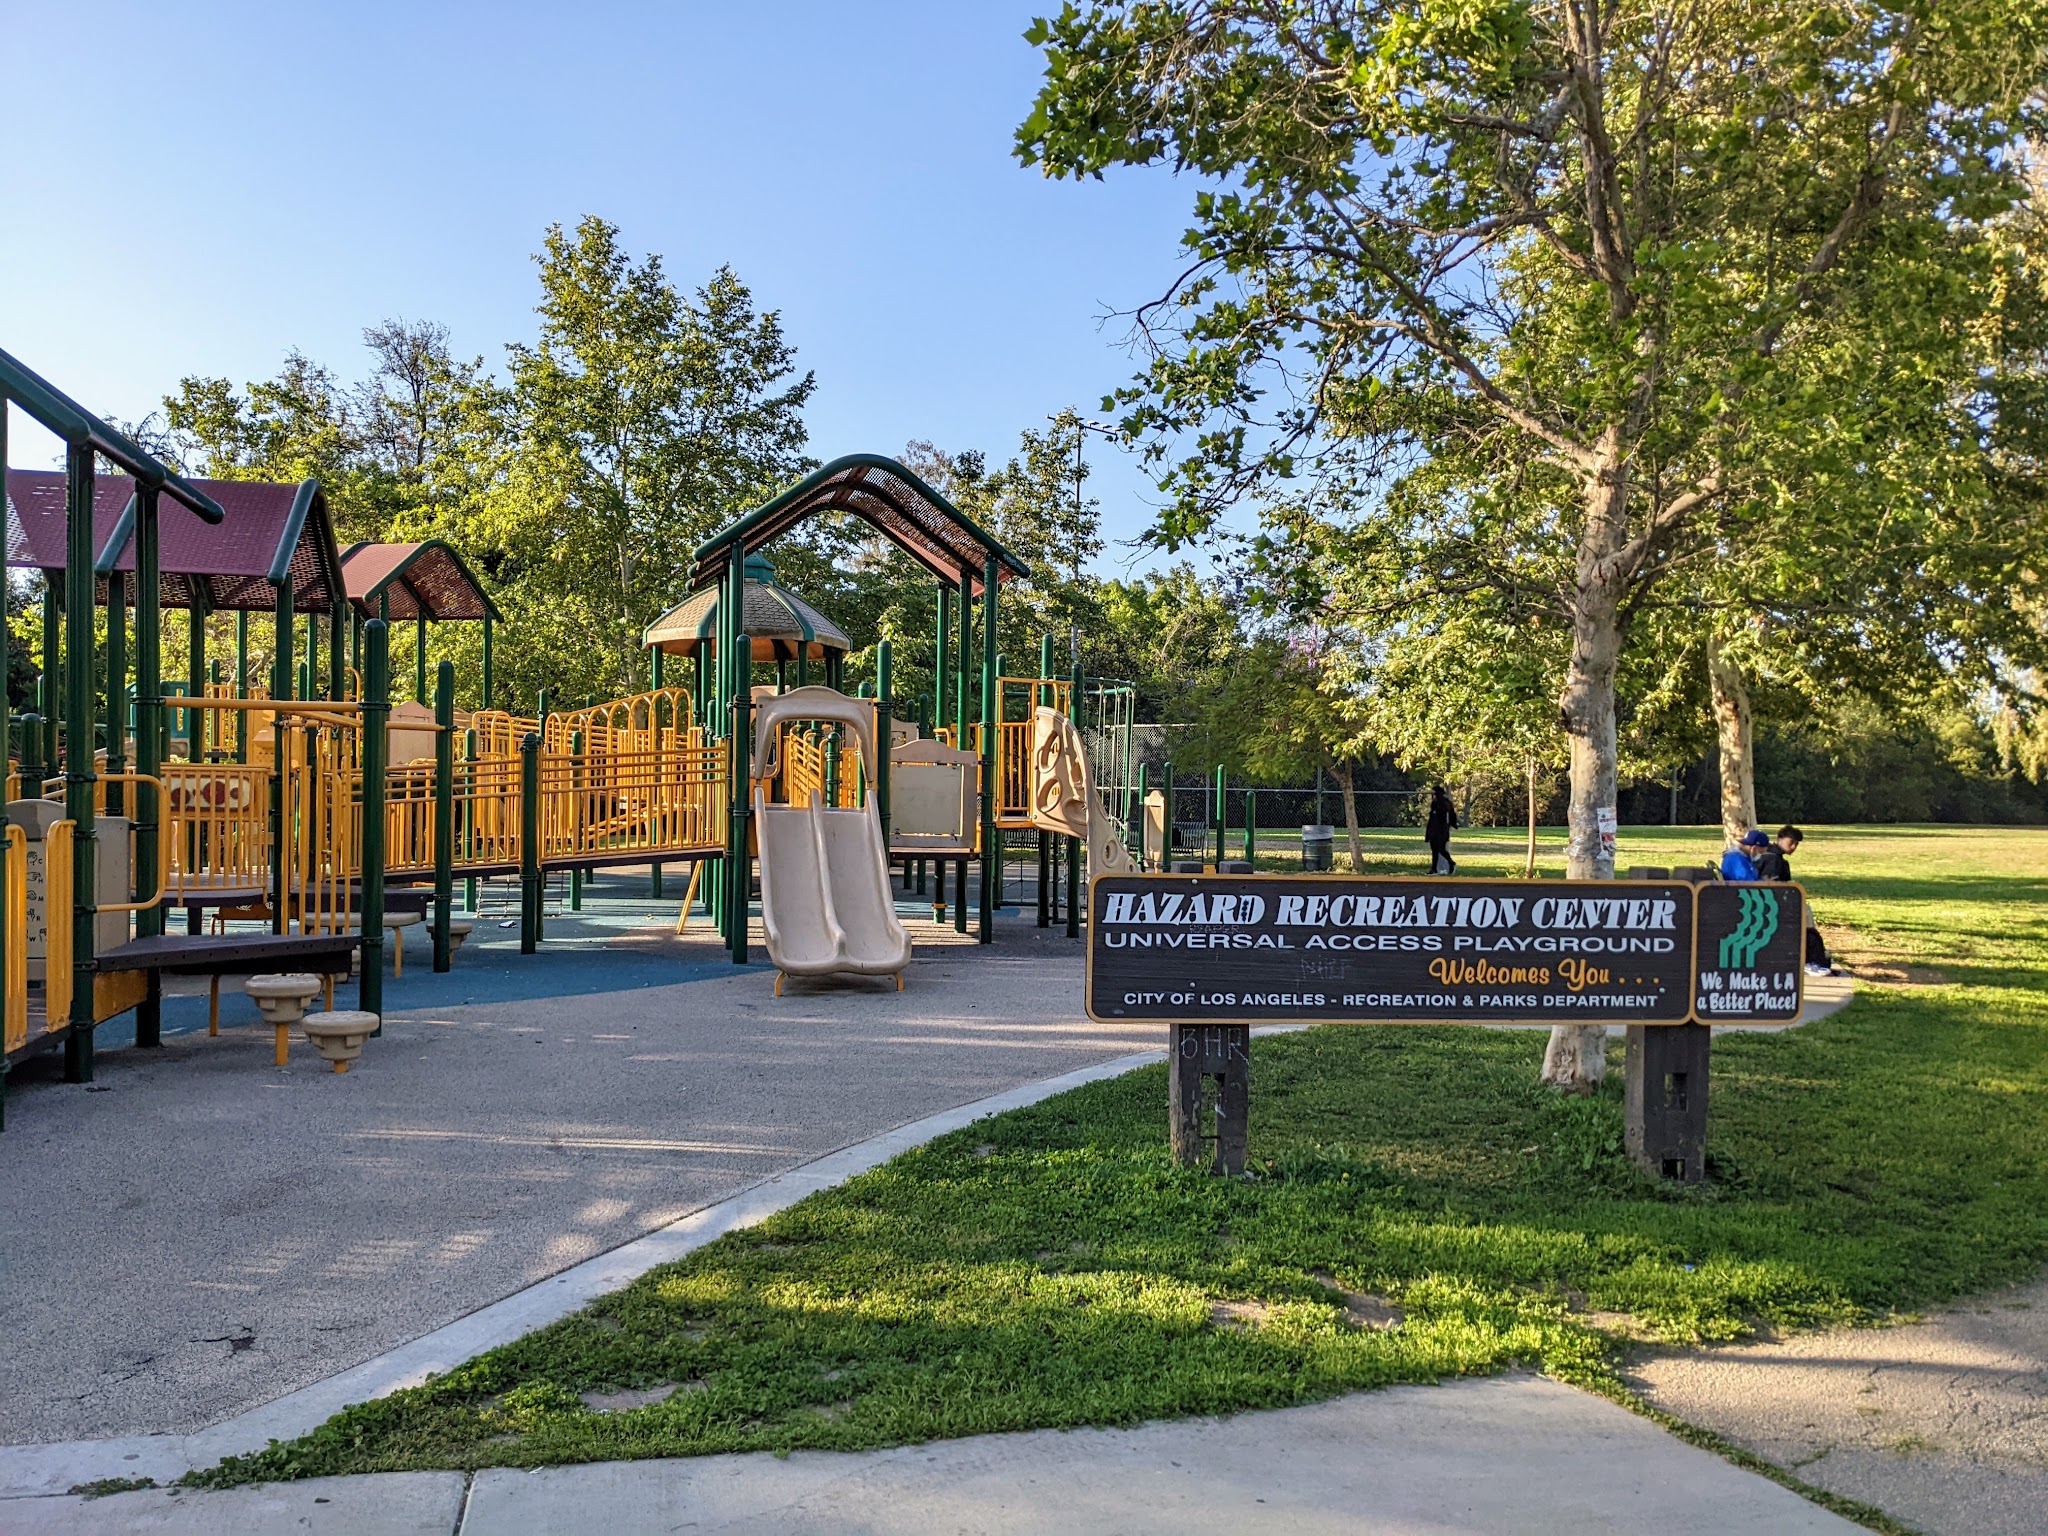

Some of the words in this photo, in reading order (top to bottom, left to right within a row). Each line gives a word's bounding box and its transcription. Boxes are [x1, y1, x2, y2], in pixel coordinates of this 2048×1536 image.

[1102, 891, 1266, 927] HAZARD
[1273, 894, 1525, 929] RECREATION
[1531, 896, 1677, 930] CENTER
[1105, 933, 1296, 949] UNIVERSAL
[1304, 934, 1443, 951] ACCESS
[1453, 936, 1675, 953] PLAYGROUND
[1429, 957, 1550, 985] Welcomes
[1558, 958, 1610, 992] You
[1701, 972, 1723, 990] We
[1729, 972, 1768, 990] Make
[1123, 992, 1165, 1005] CITY
[1170, 992, 1195, 1005] OF
[1200, 992, 1236, 1006] LOS
[1241, 993, 1326, 1006] ANGELES
[1342, 993, 1457, 1007] RECREATION
[1462, 994, 1474, 1007] &
[1479, 994, 1538, 1007] PARKS
[1542, 994, 1658, 1008] DEPARTMENT
[1697, 996, 1707, 1009] a
[1709, 992, 1752, 1010] Better
[1755, 992, 1797, 1010] Place!
